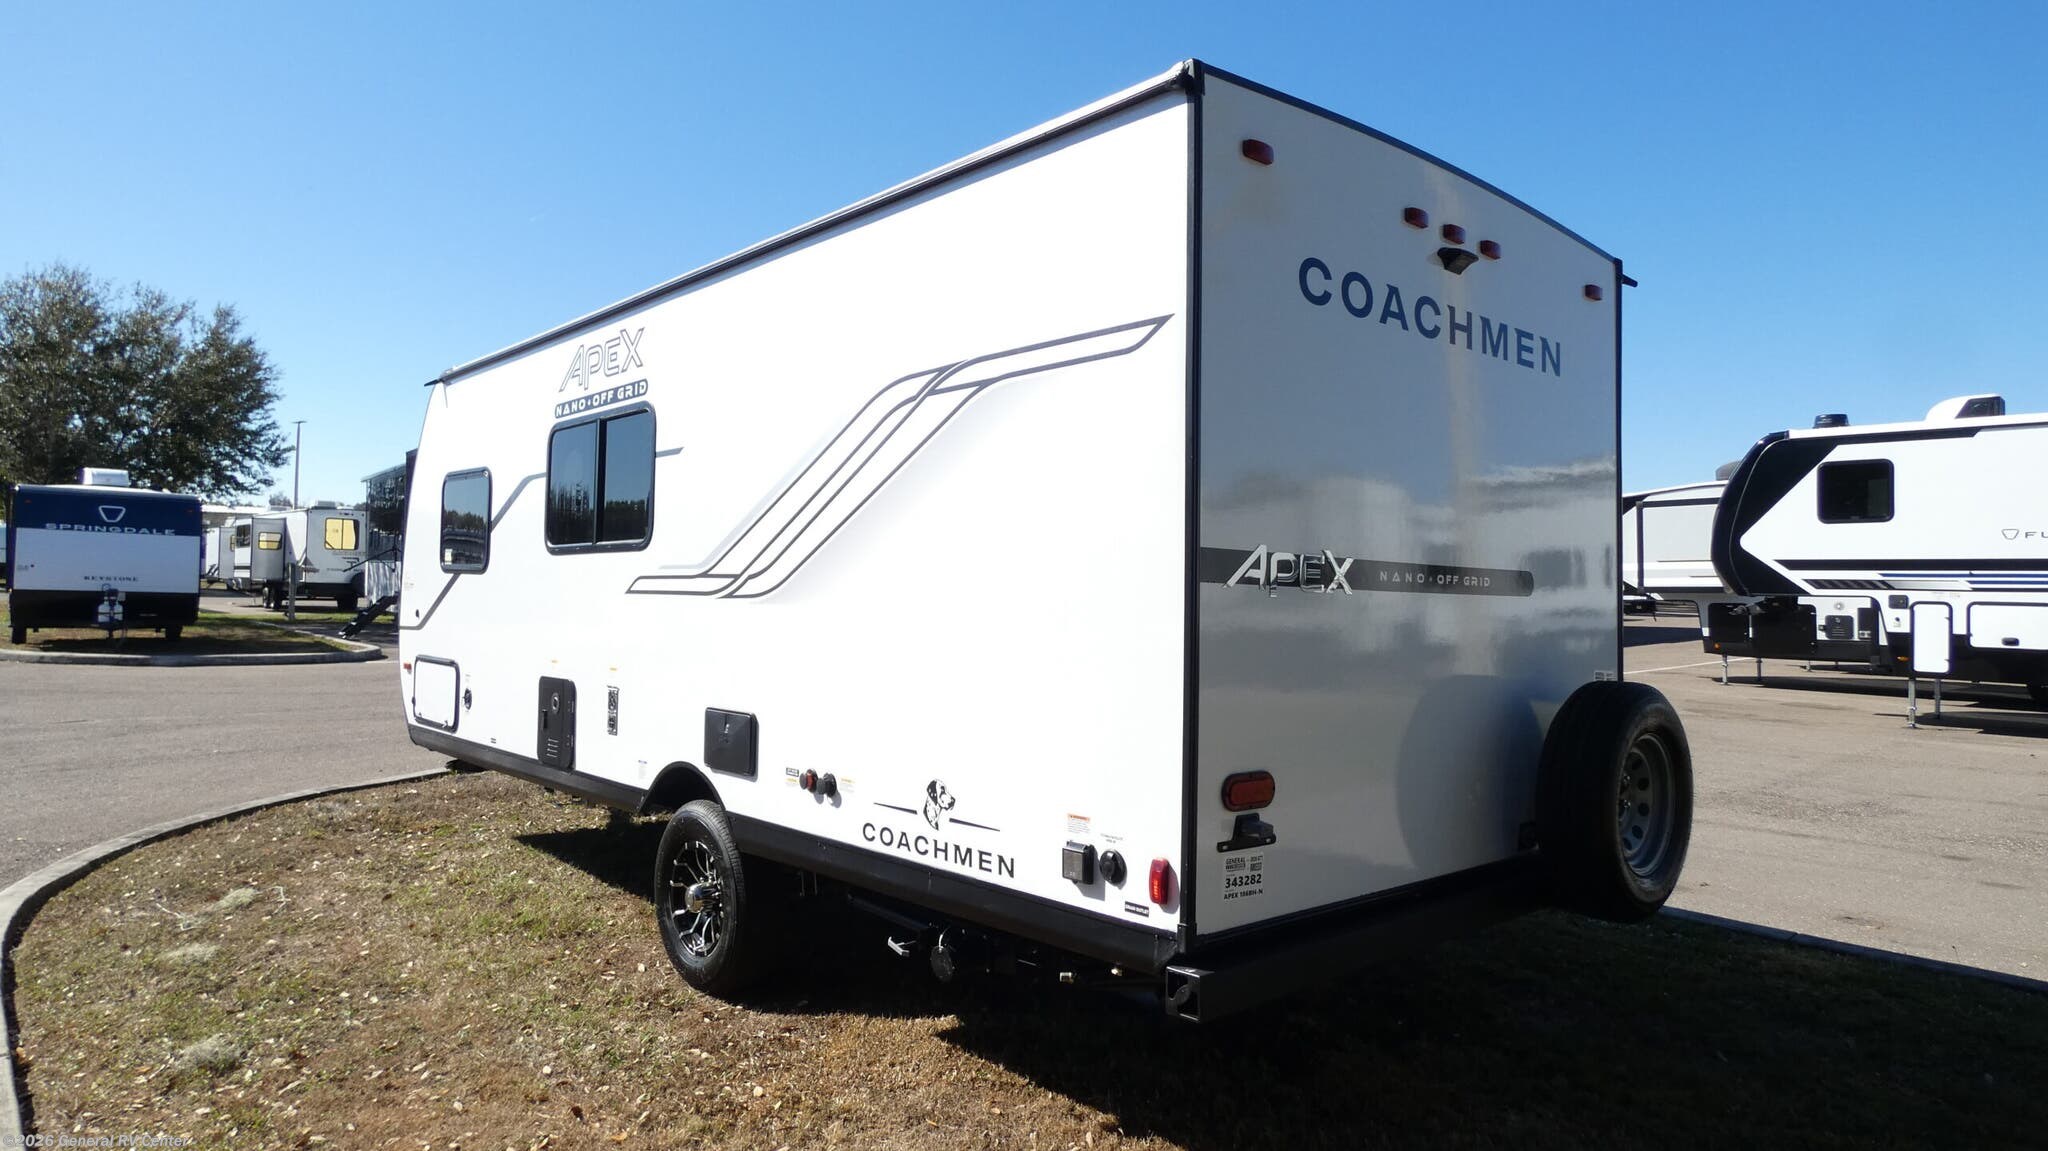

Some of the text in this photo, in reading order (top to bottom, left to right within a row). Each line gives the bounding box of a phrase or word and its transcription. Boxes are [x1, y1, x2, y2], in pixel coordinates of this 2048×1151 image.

[1298, 257, 1561, 377] COACHMEN
[559, 327, 645, 392] APEX
[555, 380, 647, 417] NANO OFF GRID
[45, 523, 176, 536] SPRINGDALE
[83, 575, 139, 583] KEYSTONE
[1223, 544, 1490, 597] APEX NANO OFF GRID
[862, 822, 1015, 879] COACHMEN
[1223, 891, 1238, 900] APEX
[1225, 873, 1262, 889] 343282
